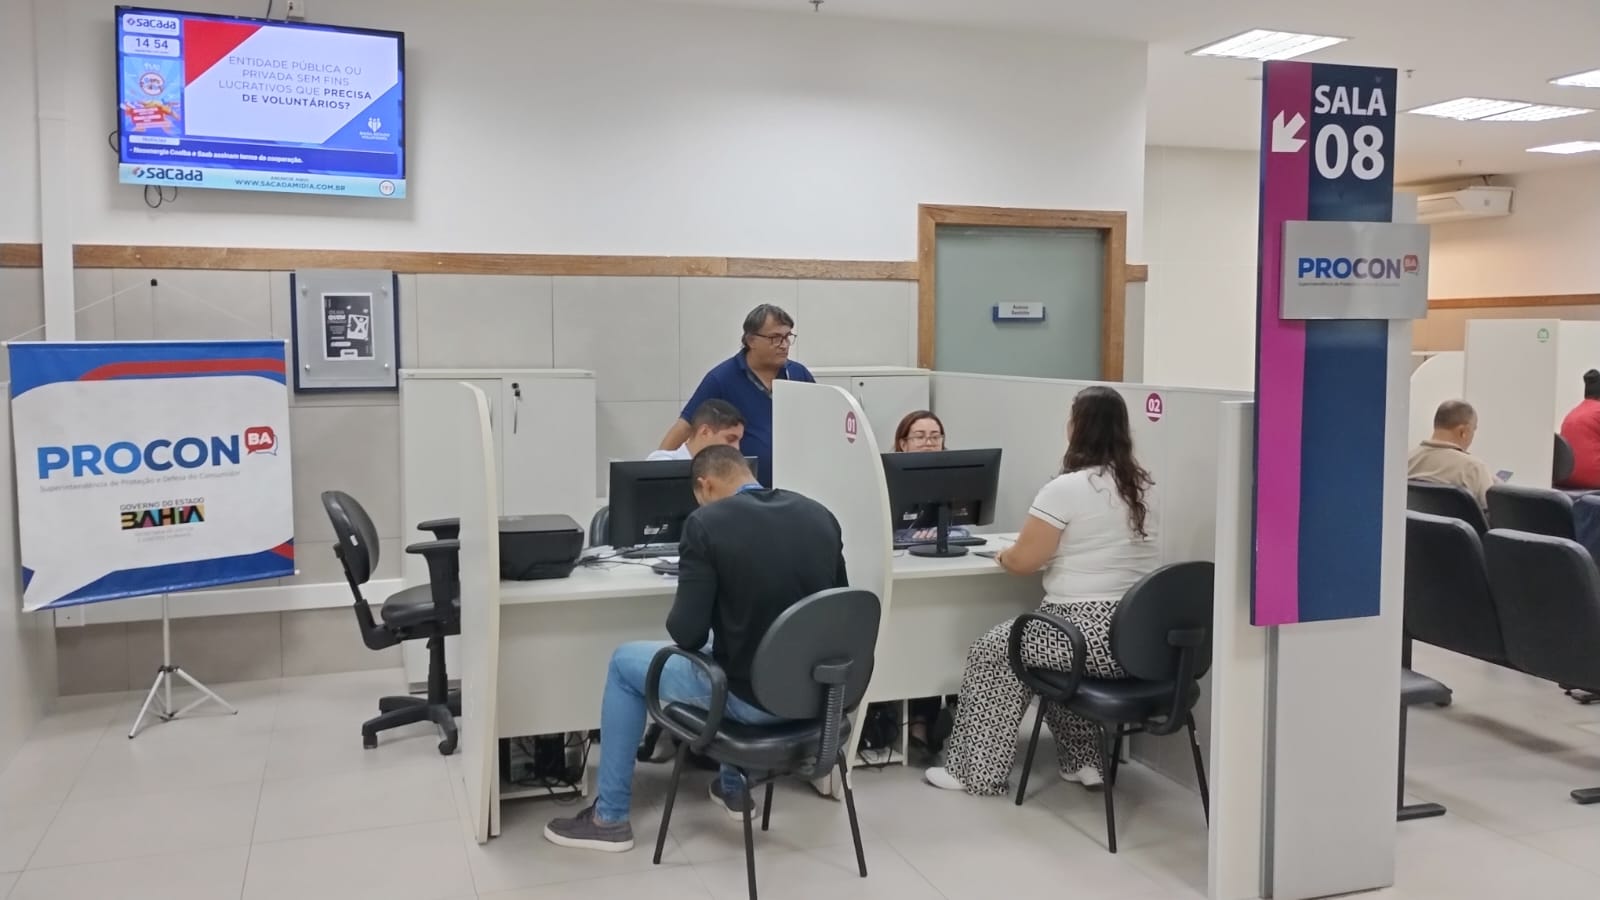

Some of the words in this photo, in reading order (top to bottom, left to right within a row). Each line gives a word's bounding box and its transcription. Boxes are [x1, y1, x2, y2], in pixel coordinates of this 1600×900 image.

[135, 38, 150, 48] 14
[154, 39, 169, 49] 54
[229, 55, 288, 69] ENTIDADE
[292, 60, 341, 73] PÚBLICA
[344, 65, 362, 75] OU
[242, 69, 293, 81] PRIVADA
[296, 73, 320, 84] SEM
[323, 76, 350, 87] FINS
[218, 80, 293, 94] LUCRATIVOS
[296, 85, 320, 96] QUE
[323, 87, 372, 100] PRECISA
[242, 94, 258, 103] DE
[262, 95, 351, 110] VOLUNTÁRIOS?
[1314, 84, 1388, 117] SALA
[1314, 123, 1385, 181] 08
[234, 178, 346, 191] WWW.SACADAMIDIA.COM.BR
[1298, 257, 1401, 279] PROCON
[1148, 398, 1160, 412] 02
[847, 417, 855, 432] 01
[37, 434, 240, 480] PROCON
[247, 431, 272, 446] BA
[120, 501, 160, 511] GOVERNO
[162, 499, 174, 507] DO
[175, 496, 205, 506] ESTADO
[121, 505, 205, 530] BAHIA
